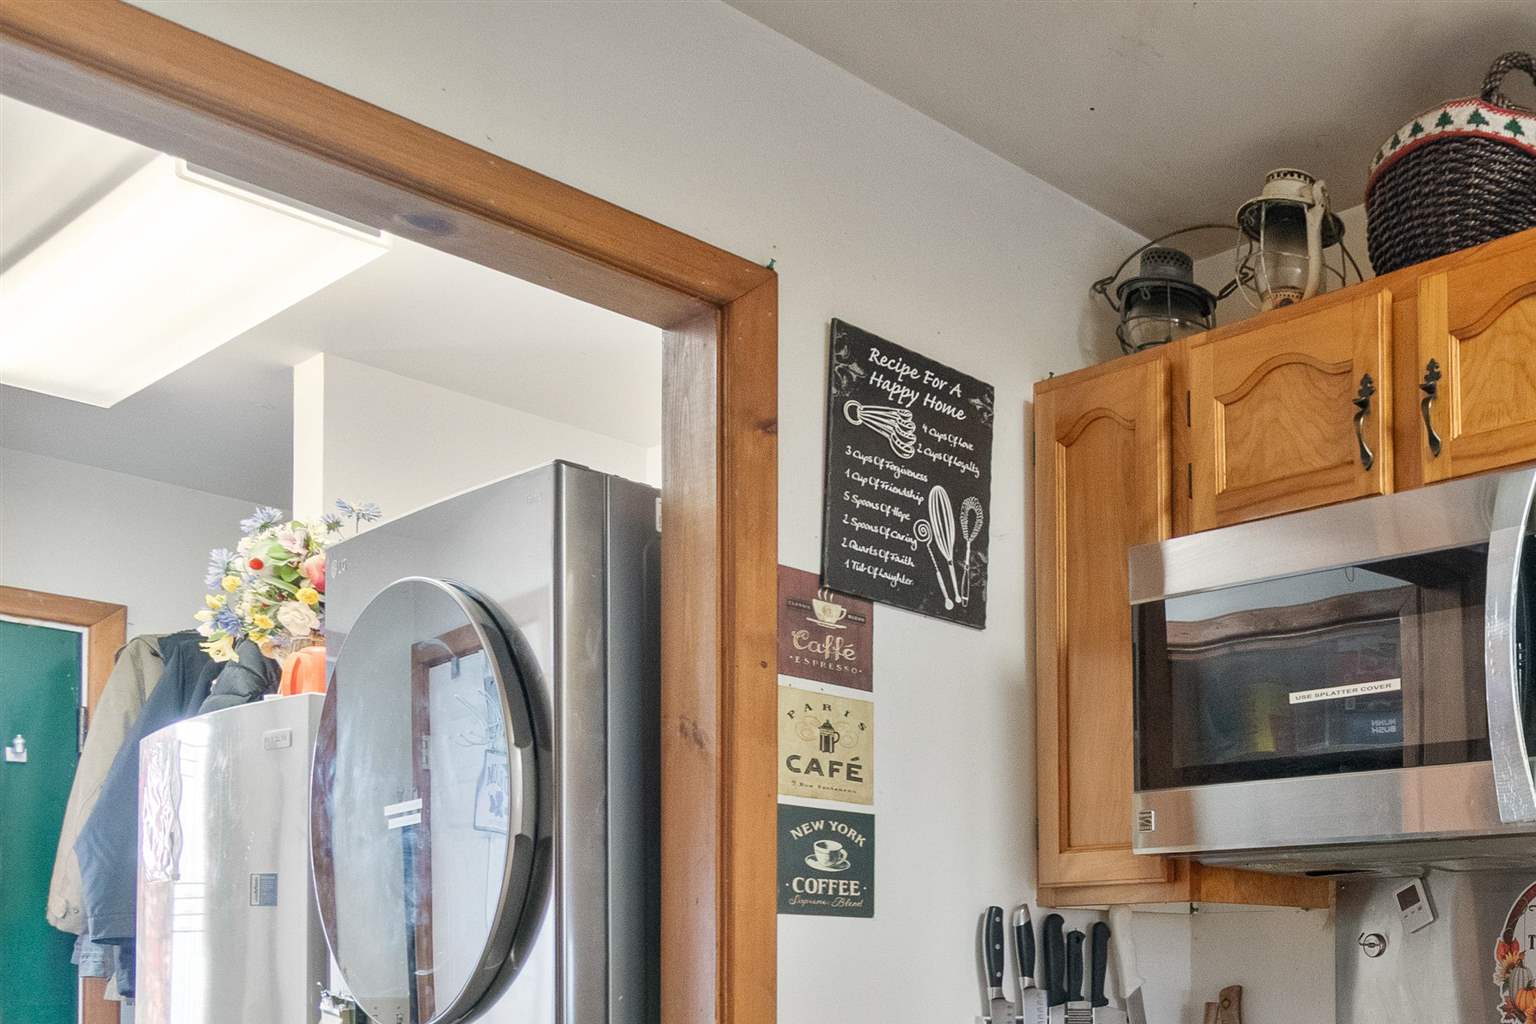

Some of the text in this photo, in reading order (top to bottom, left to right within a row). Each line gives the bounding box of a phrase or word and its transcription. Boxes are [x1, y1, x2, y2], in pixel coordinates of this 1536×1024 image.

[868, 347, 962, 398] Recipe For A
[868, 371, 967, 420] Happy Home
[928, 427, 947, 443] Cups
[948, 433, 959, 448] Of
[958, 437, 974, 451] Love
[844, 445, 928, 483] 3 Cups Of Forgiveness
[923, 447, 943, 462] Cups
[943, 453, 953, 467] Of
[953, 456, 980, 478] Loyalty
[844, 468, 925, 506] 1 Cup Of Friendship
[843, 490, 911, 523] 5 Spoons Of Hope
[850, 517, 879, 531] Spoons
[879, 525, 891, 540] Of
[890, 530, 918, 551] Caring
[848, 539, 878, 556] Quarts
[878, 549, 890, 563] Of
[889, 552, 915, 568] Faith
[844, 559, 850, 568] 1
[851, 559, 867, 572] Tub
[867, 565, 879, 579] Of
[791, 629, 857, 661] Caffé
[795, 656, 858, 674] ESPRESSO
[1314, 687, 1359, 698] SPLATTER
[1360, 682, 1393, 692] COVER
[786, 703, 868, 731] PARIS
[786, 754, 864, 783] CAFÉ
[789, 820, 867, 847] NEW YORK
[791, 876, 861, 896] COFFEE
